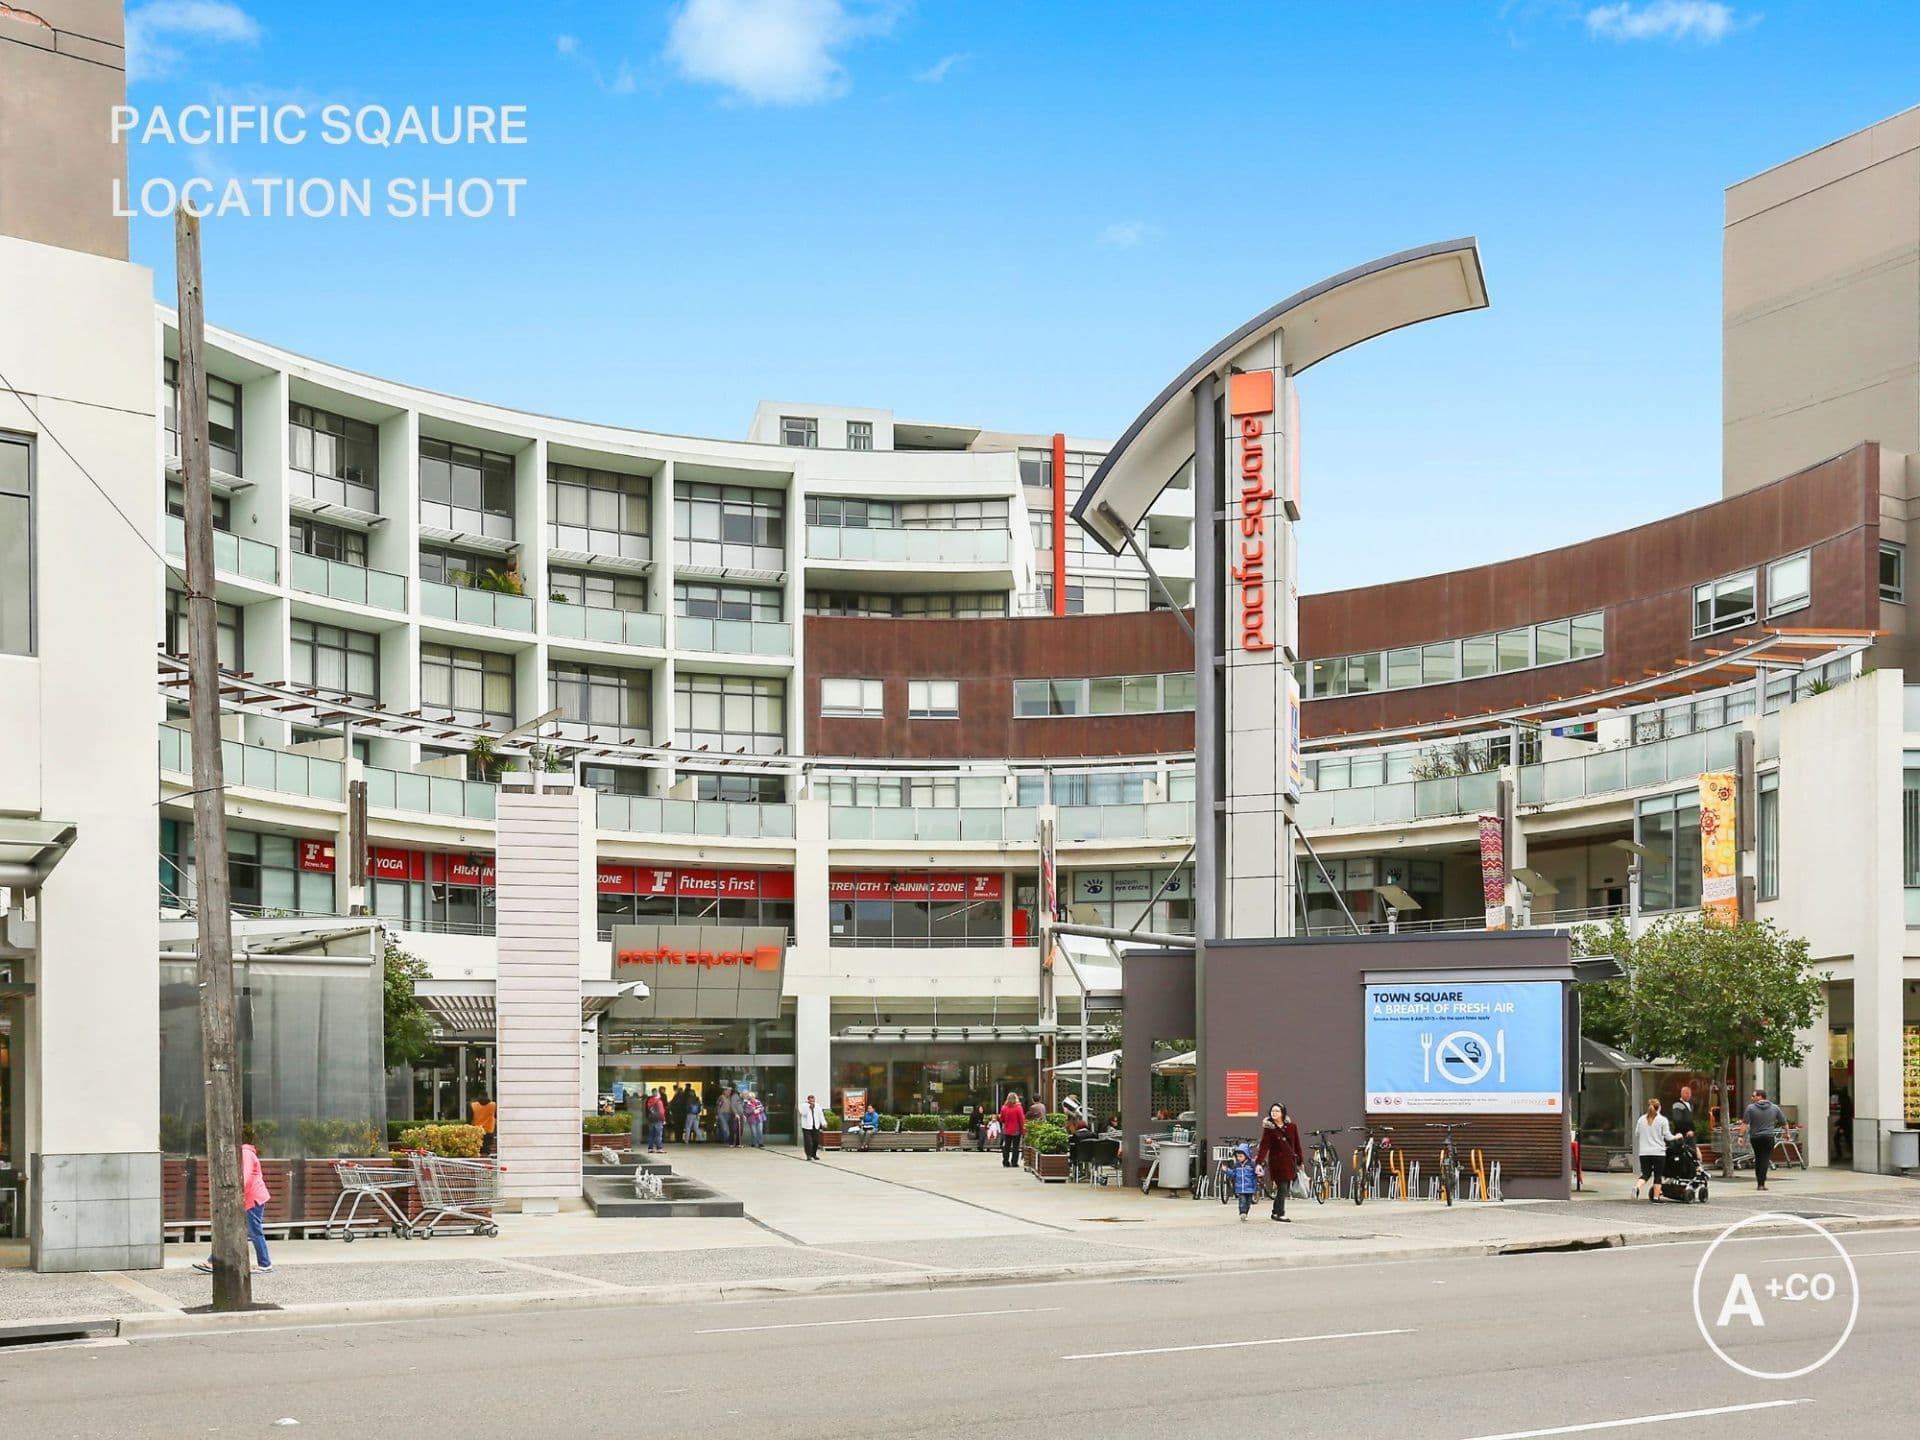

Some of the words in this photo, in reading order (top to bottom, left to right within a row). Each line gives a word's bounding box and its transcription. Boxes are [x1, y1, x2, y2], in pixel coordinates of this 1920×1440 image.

[1240, 415, 1274, 539] square
[1231, 540, 1274, 651] pacific
[376, 857, 403, 870] YOGA
[453, 864, 480, 876] HIGH
[597, 874, 623, 885] ZONE
[830, 881, 881, 891] TRENGTH
[937, 882, 965, 892] ZONE
[617, 945, 682, 969] pacific
[685, 951, 754, 971] square
[1373, 992, 1410, 1003] TOWN
[1414, 992, 1463, 1003] SQUARE
[1373, 1004, 1383, 1015] A
[1386, 1004, 1430, 1015] BREATH
[1434, 1003, 1449, 1014] OF
[1453, 1002, 1490, 1014] FRESH
[1494, 1001, 1515, 1013] AIR
